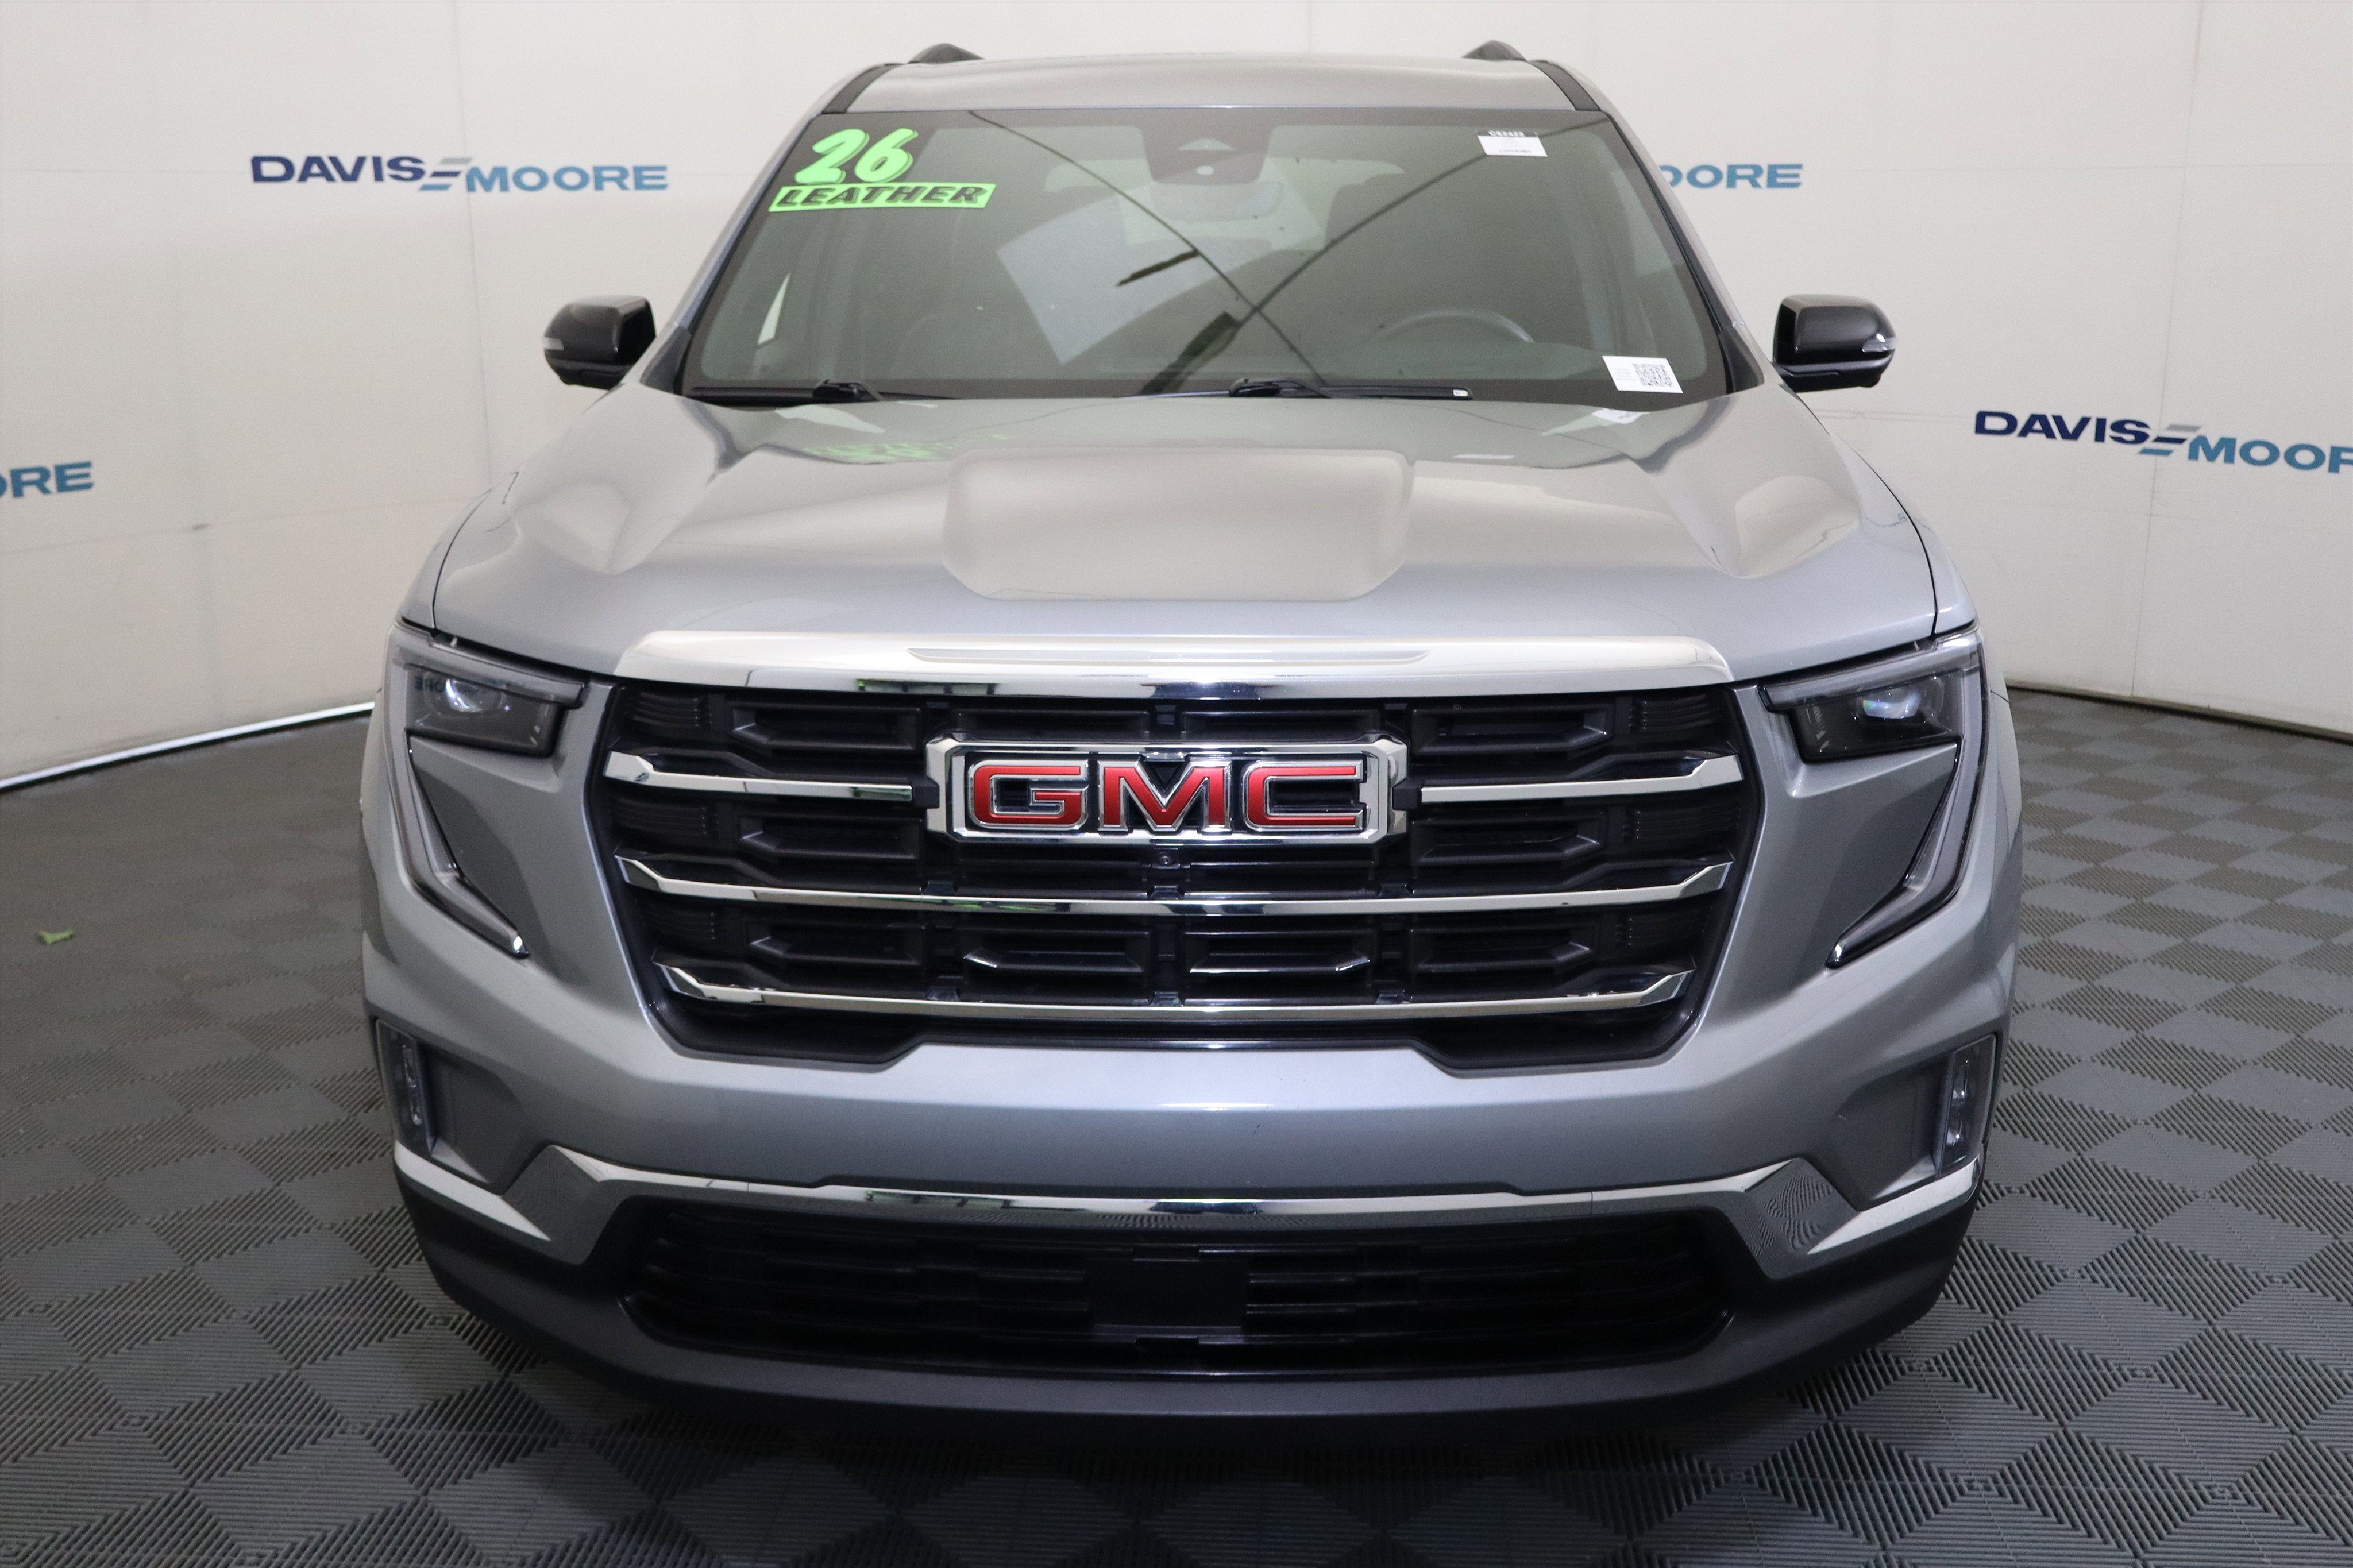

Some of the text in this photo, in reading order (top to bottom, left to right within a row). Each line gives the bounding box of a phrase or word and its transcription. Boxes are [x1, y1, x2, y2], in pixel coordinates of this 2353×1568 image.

[251, 155, 669, 192] DAVIS MOORE
[794, 128, 919, 184] 26
[776, 186, 988, 207] LEATHER
[1975, 410, 2150, 445] DAVIS
[0, 461, 94, 498] RE
[969, 759, 1364, 832] GMC
